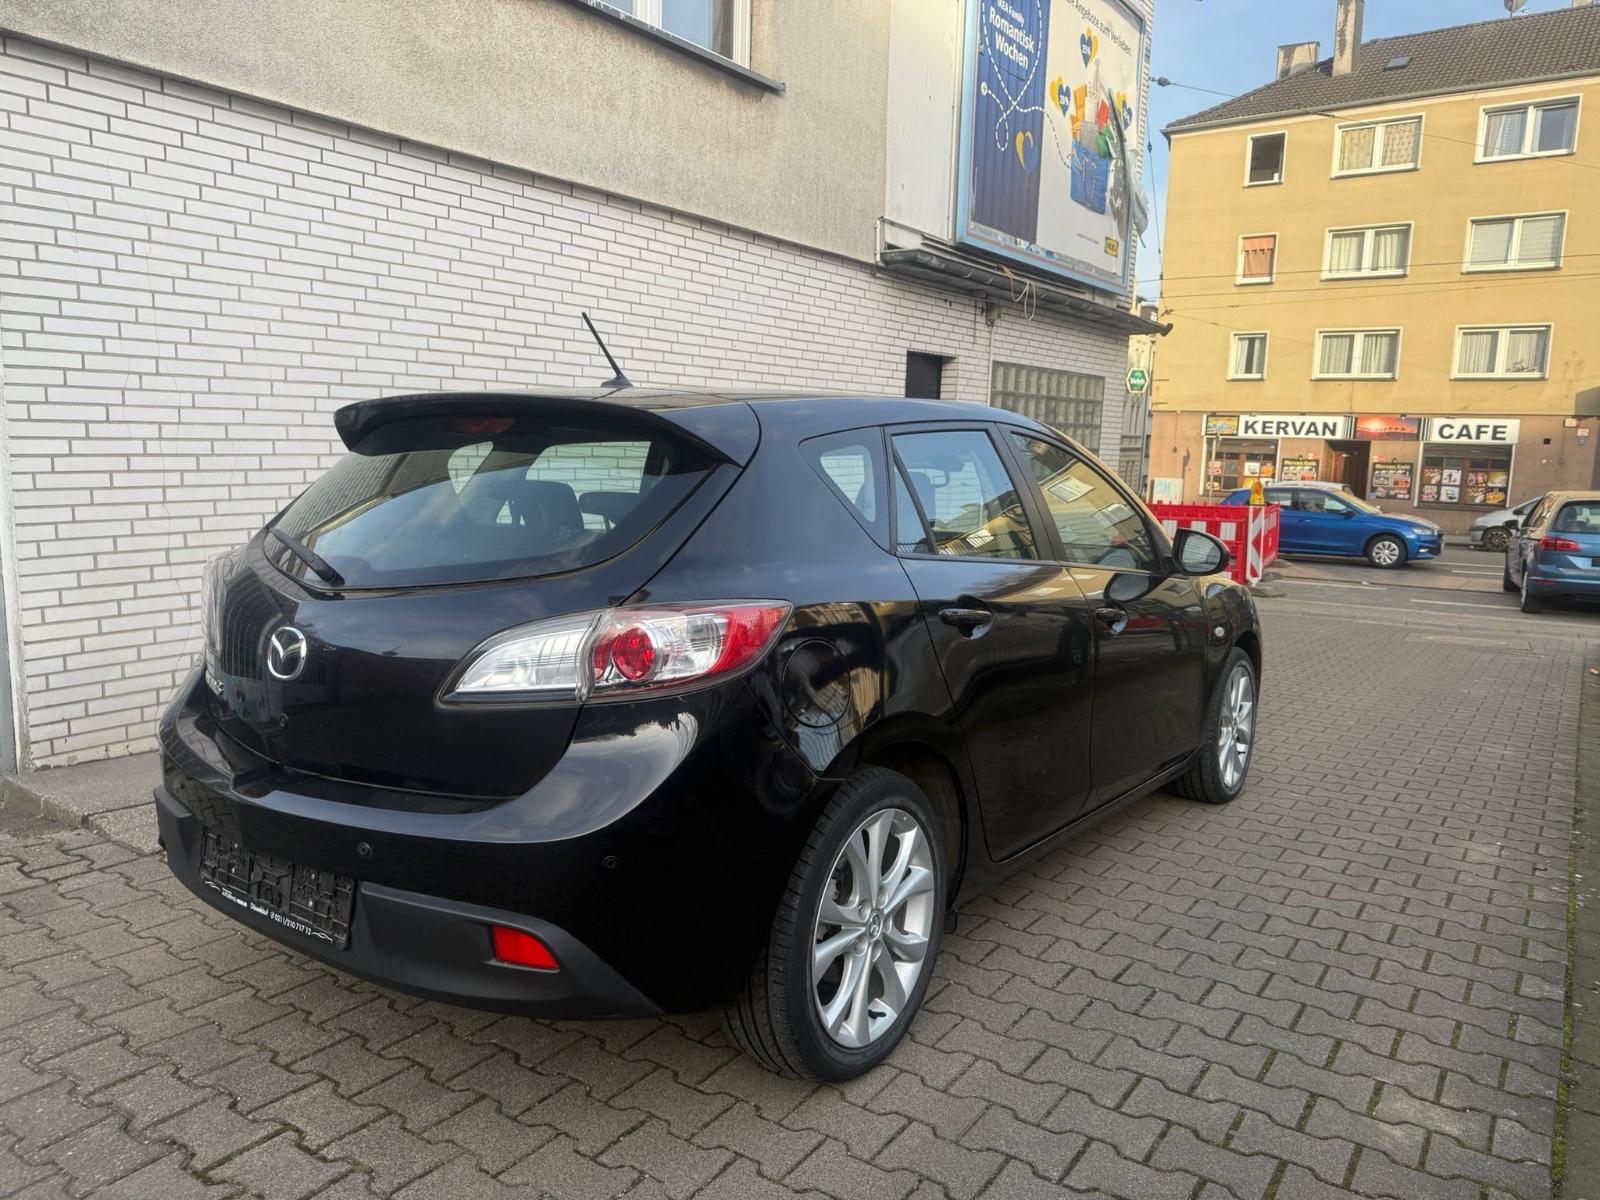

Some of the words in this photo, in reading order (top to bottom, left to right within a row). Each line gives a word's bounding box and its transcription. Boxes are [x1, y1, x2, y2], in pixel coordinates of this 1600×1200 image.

[1009, 6, 1026, 27] Family
[995, 31, 1029, 70] Wochen
[1243, 420, 1338, 437] KERVAN
[1438, 423, 1508, 441] CAFE
